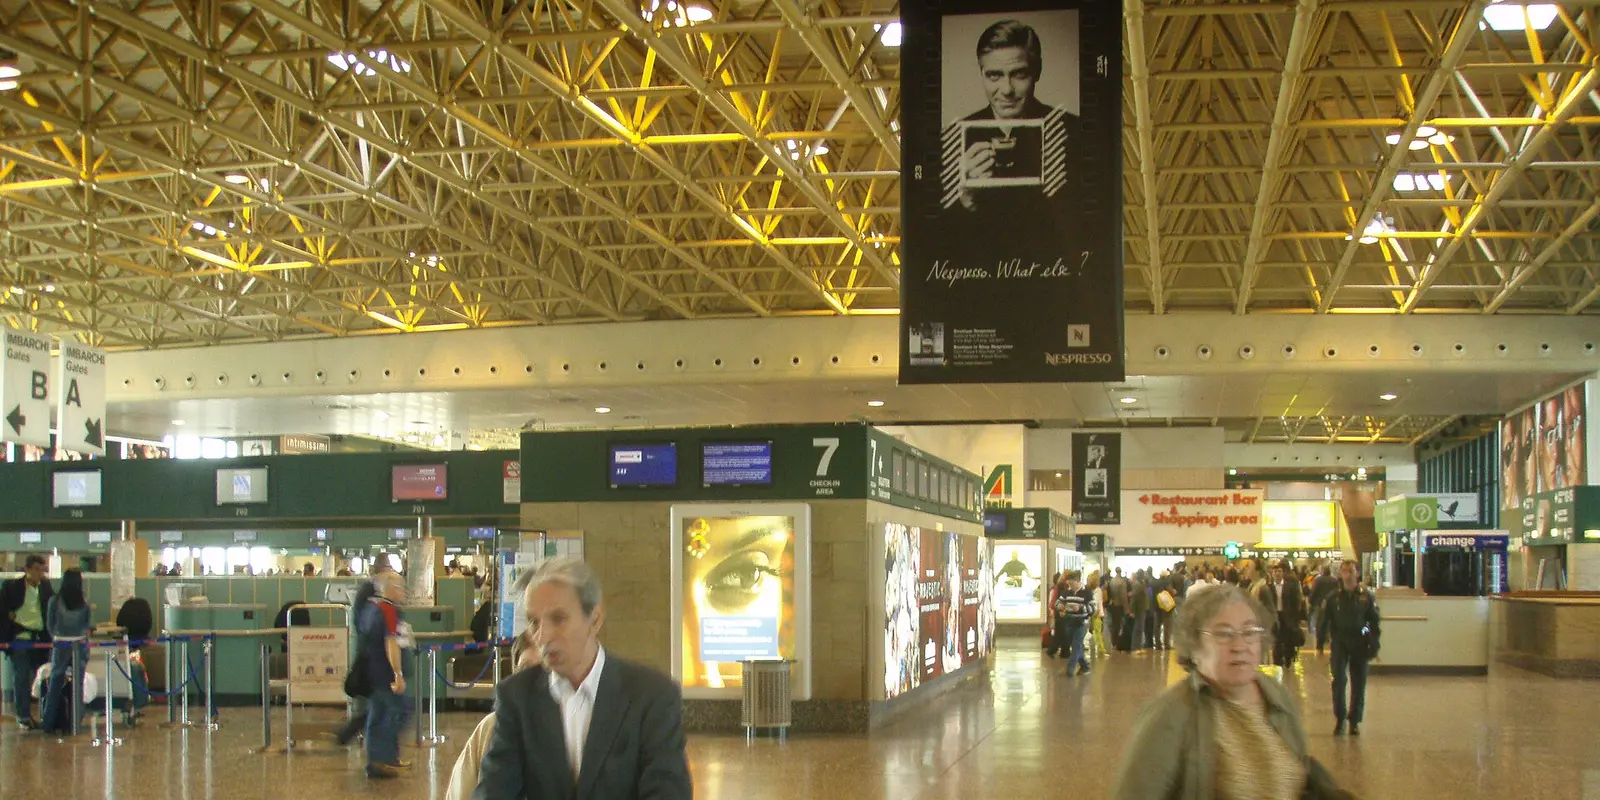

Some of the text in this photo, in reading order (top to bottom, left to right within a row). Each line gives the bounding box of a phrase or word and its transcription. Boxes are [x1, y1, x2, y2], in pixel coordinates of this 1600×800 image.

[914, 164, 923, 180] 23
[926, 259, 992, 288] Nespresso.
[996, 258, 1040, 279] What
[1040, 257, 1070, 278] else
[6, 333, 50, 352] IMBARCHI
[6, 348, 31, 363] Gates
[66, 347, 105, 365] IMBARCHI
[1044, 351, 1112, 366] NESPRESSO
[65, 360, 89, 375] Gates
[31, 369, 48, 401] B
[66, 378, 82, 408] A
[287, 437, 328, 452] intimissimi
[812, 437, 840, 477] 7
[870, 438, 877, 477] 7
[809, 480, 841, 488] CHECK-IN
[815, 488, 834, 496] AREA
[1151, 493, 1258, 506] Restaurant Bar
[412, 504, 425, 514] 701
[1023, 511, 1036, 530] 5
[1151, 511, 1259, 528] Shopping area
[1090, 536, 1098, 547] 3
[1431, 536, 1476, 548] change
